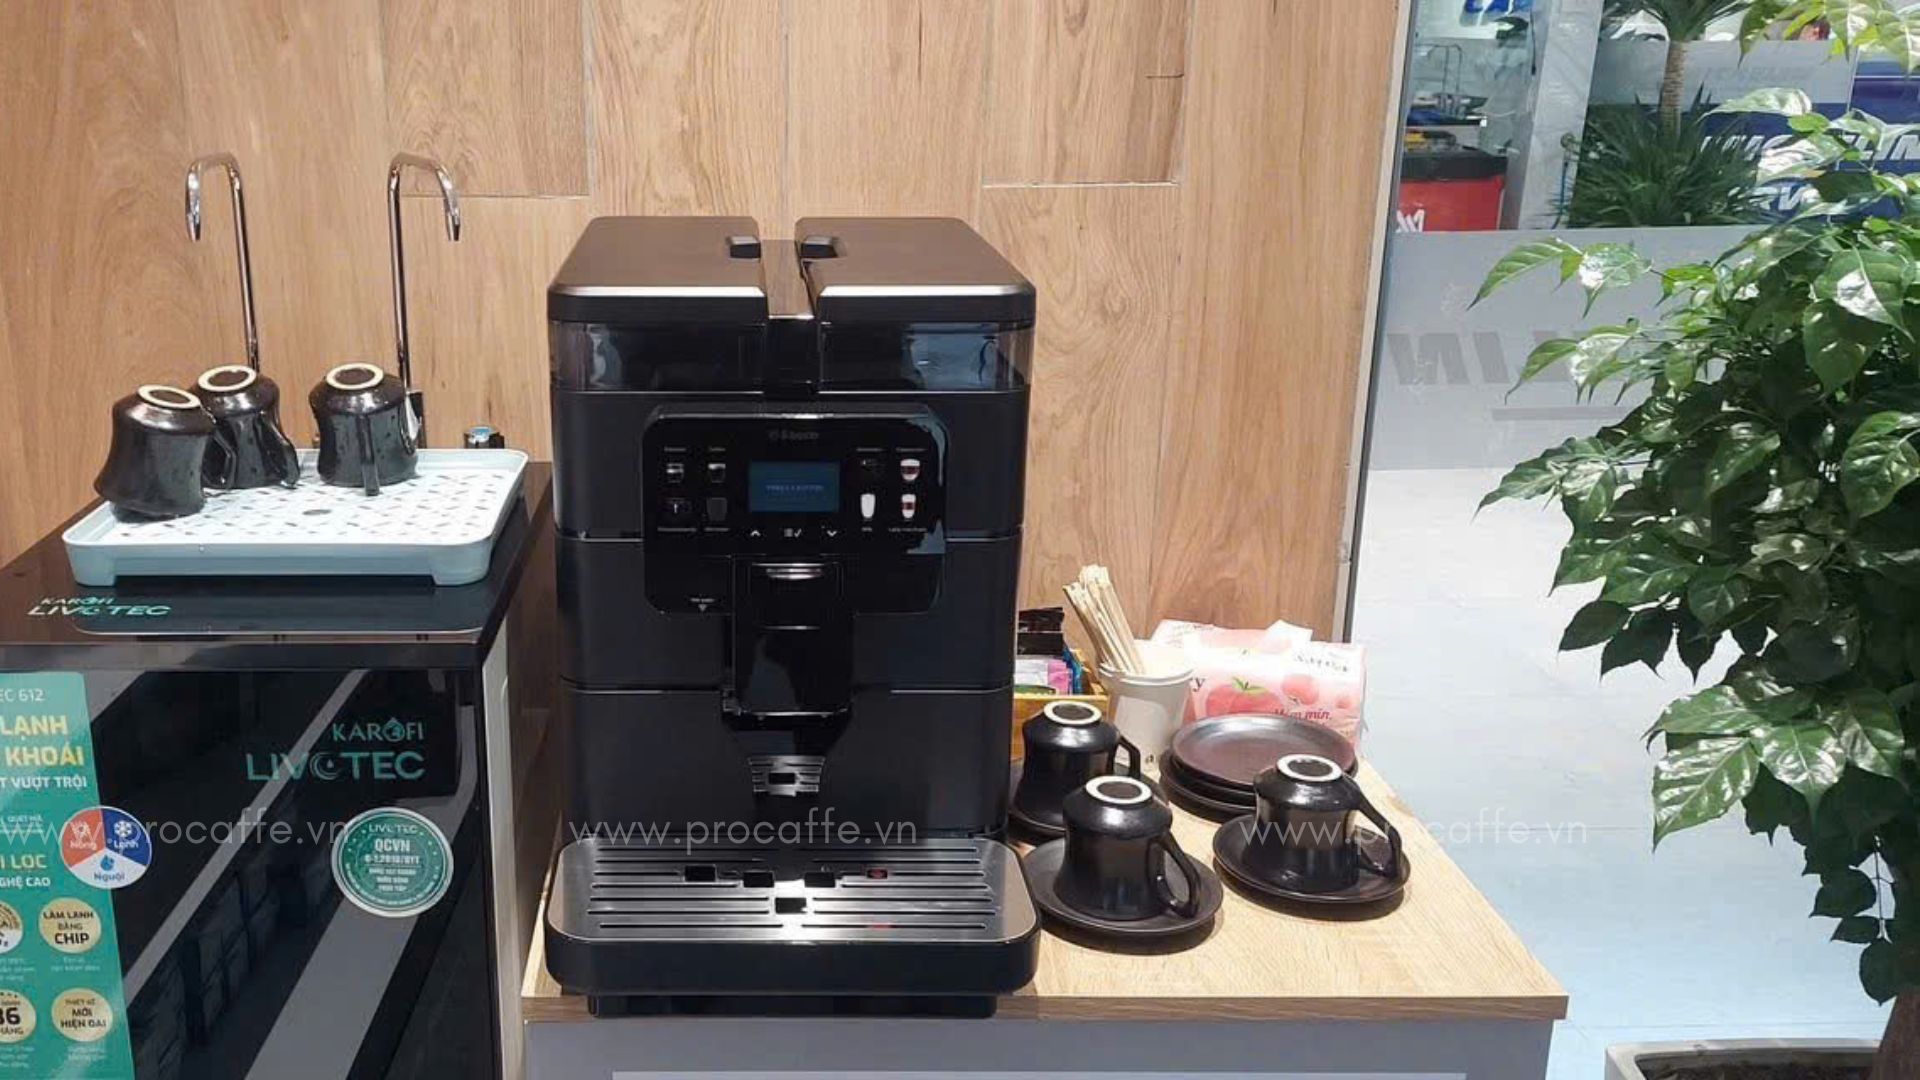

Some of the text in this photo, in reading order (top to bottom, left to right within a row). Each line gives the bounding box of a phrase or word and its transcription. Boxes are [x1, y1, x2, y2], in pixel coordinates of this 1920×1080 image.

[18, 688, 45, 702] 612
[332, 717, 425, 743] KAROFI
[5, 741, 85, 767] KHOÁI
[246, 752, 426, 781] LIVOTEC
[53, 774, 87, 791] TRỘI
[375, 838, 411, 853] QCVN
[26, 876, 52, 888] CAO
[54, 932, 91, 945] CHIP
